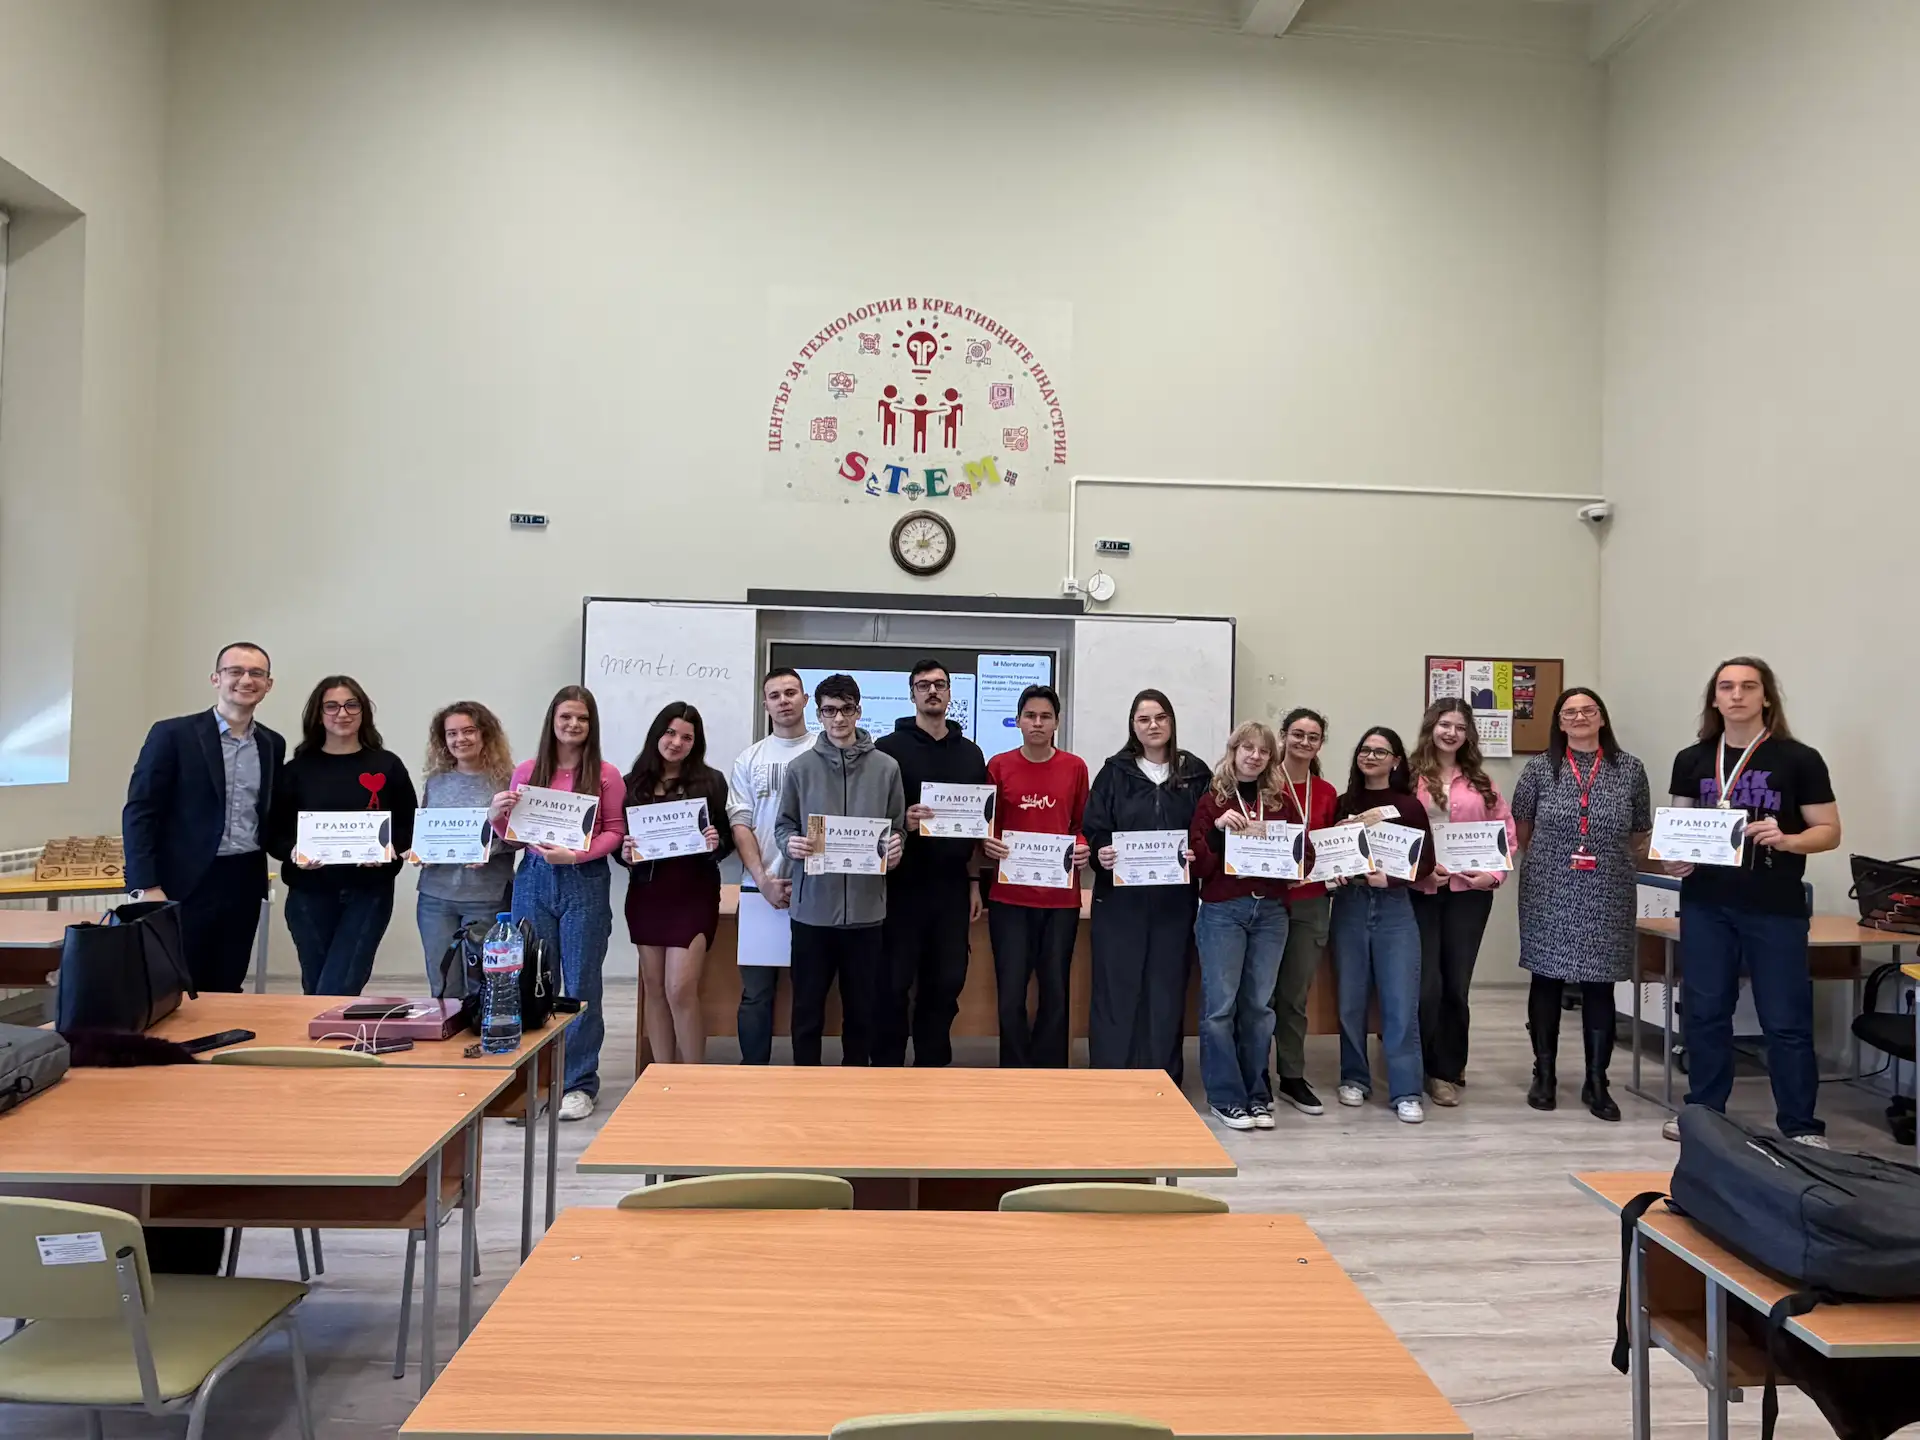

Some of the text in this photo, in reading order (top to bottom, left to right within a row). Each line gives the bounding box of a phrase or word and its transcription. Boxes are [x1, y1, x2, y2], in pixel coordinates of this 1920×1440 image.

[768, 297, 1067, 465] ЦЕНТЪР ЗА ТЕХНОЛОГИИ В КРЕАТИВНИТЕ ИНДУСТРИИ
[839, 451, 1000, 498] STEM
[511, 515, 533, 524] EXIT
[1098, 541, 1119, 550] EXIT
[1497, 664, 1508, 690] 2026
[934, 794, 982, 803] ГРАМОТА
[529, 798, 581, 813] ГРАМОТА
[642, 811, 694, 824] ГРАМОТА
[315, 821, 374, 830] ГРАМОТА
[428, 819, 479, 828] ГРАМОТА
[1669, 819, 1728, 829] ГРАМОТА
[828, 827, 875, 837] РАМОТА
[1446, 832, 1493, 841] ГРАМОТА
[1014, 842, 1061, 853] ГРАМОТА
[1126, 842, 1174, 851] ГРАМОТА
